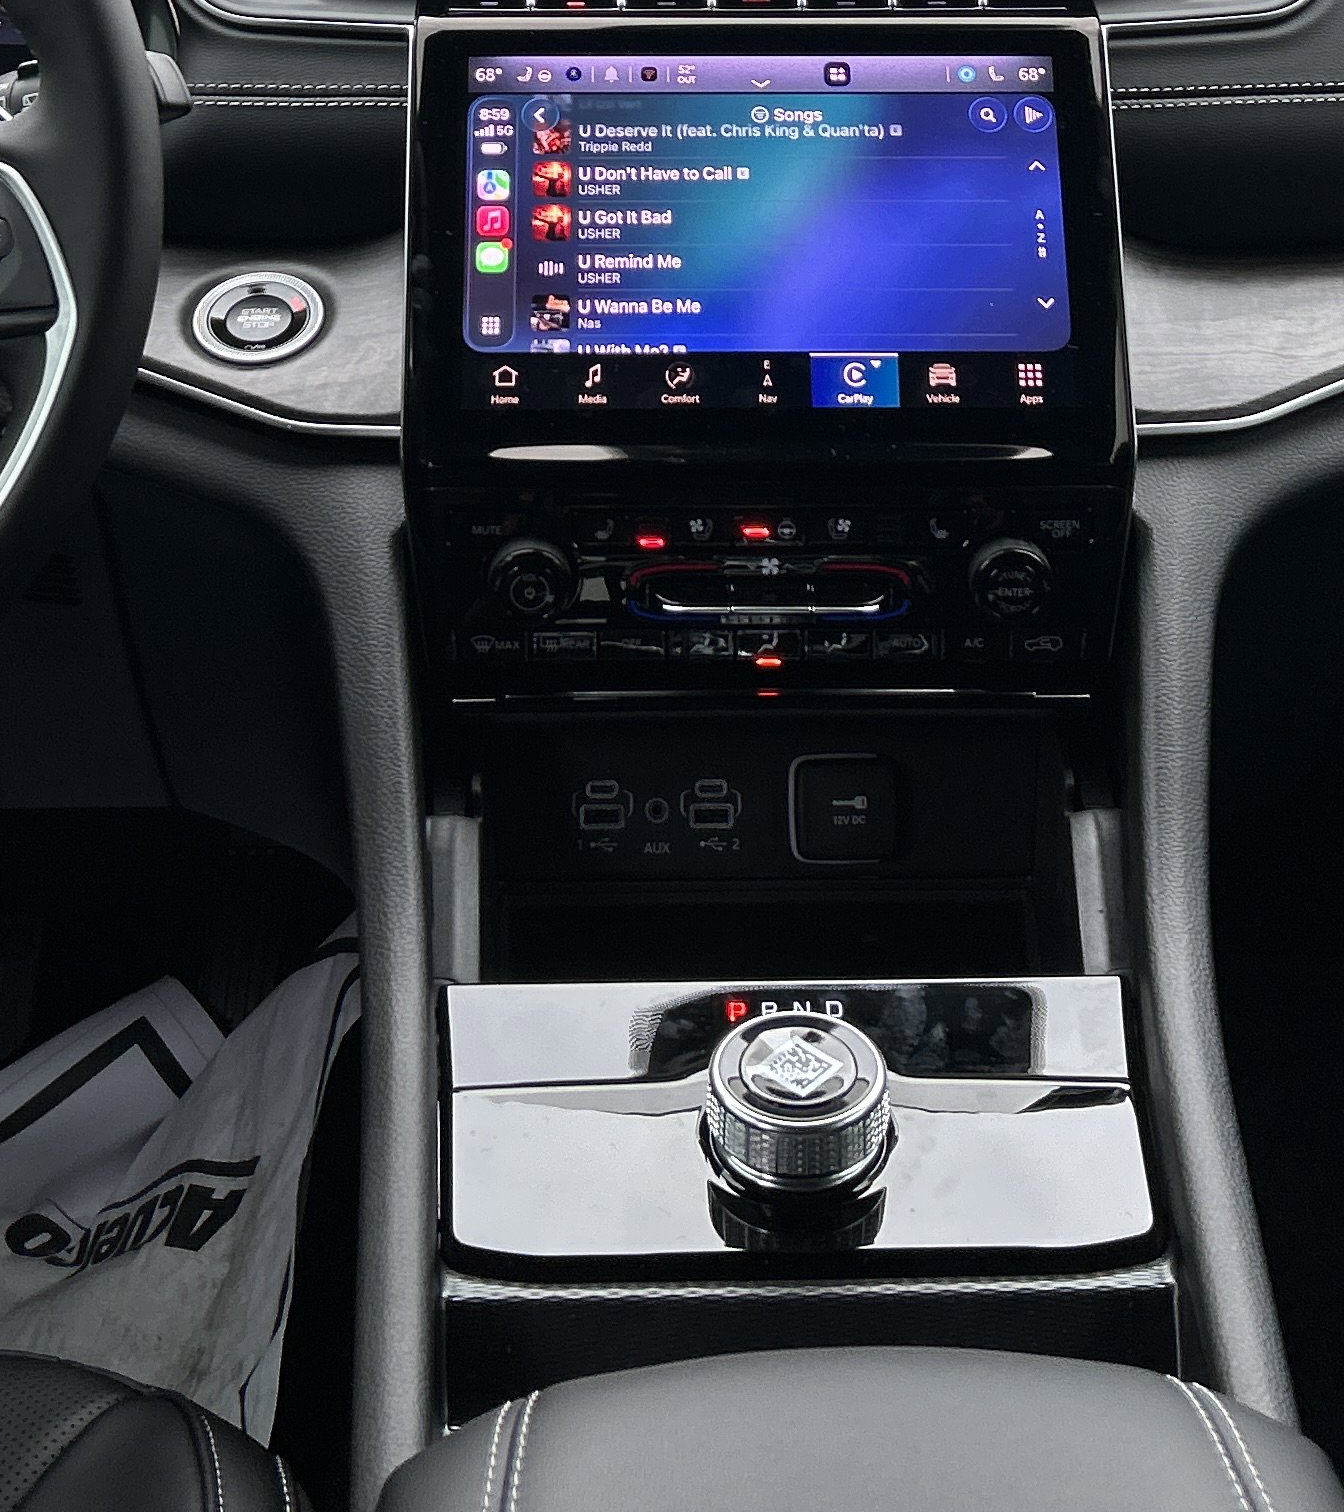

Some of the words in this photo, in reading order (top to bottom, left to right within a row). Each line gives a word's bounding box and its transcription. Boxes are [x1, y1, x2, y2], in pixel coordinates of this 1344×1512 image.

[677, 74, 697, 84] OUT
[478, 108, 510, 121] 8:59
[773, 108, 823, 123] Songs
[496, 125, 514, 136] 5G
[579, 125, 591, 137] U
[595, 125, 658, 137] Deserve
[661, 125, 672, 137] It
[677, 124, 717, 139] (feat.
[720, 124, 761, 137] Chris
[764, 124, 799, 139] King
[802, 124, 815, 137] &
[818, 123, 885, 140] Quan'ta)
[579, 141, 618, 153] Trippie
[622, 141, 652, 152] Redd
[578, 167, 591, 180] U
[595, 167, 638, 180] Don't
[641, 167, 680, 180] Have
[683, 168, 699, 180] to
[703, 166, 732, 180] Call
[578, 185, 621, 195] USHER
[578, 211, 591, 224] U
[594, 210, 623, 225] Got
[626, 211, 638, 224] It
[641, 210, 672, 225] Bad
[578, 229, 621, 239] USHER
[578, 255, 591, 268] U
[594, 253, 653, 268] Remind
[657, 255, 682, 268] Me
[578, 273, 621, 284] USHER
[241, 307, 279, 315] START
[577, 299, 590, 313] U
[594, 299, 648, 313] Wanna
[651, 299, 673, 313] Be
[676, 299, 701, 313] Me
[237, 314, 281, 322] ENGINE
[577, 318, 601, 329] Nas
[242, 321, 274, 329] STOP
[594, 344, 631, 354] With
[491, 394, 519, 405] Home
[578, 394, 607, 405] Media
[661, 393, 700, 405] Comfort
[758, 393, 778, 404] Nav
[837, 393, 874, 406] CarPlay
[926, 393, 960, 404] Vehicle
[1019, 394, 1044, 406] Apps
[472, 525, 503, 535] MUTE
[1039, 519, 1080, 530] SCREEN
[1051, 528, 1072, 539] OFF
[997, 587, 1034, 597] ENTER
[495, 640, 520, 650] MAX
[964, 637, 985, 648] A/C
[833, 816, 851, 825] 12V
[852, 816, 867, 825] DC
[643, 842, 671, 855] AUX
[731, 838, 741, 850] 2
[726, 1001, 748, 1023] P
[826, 1000, 843, 1018] D
